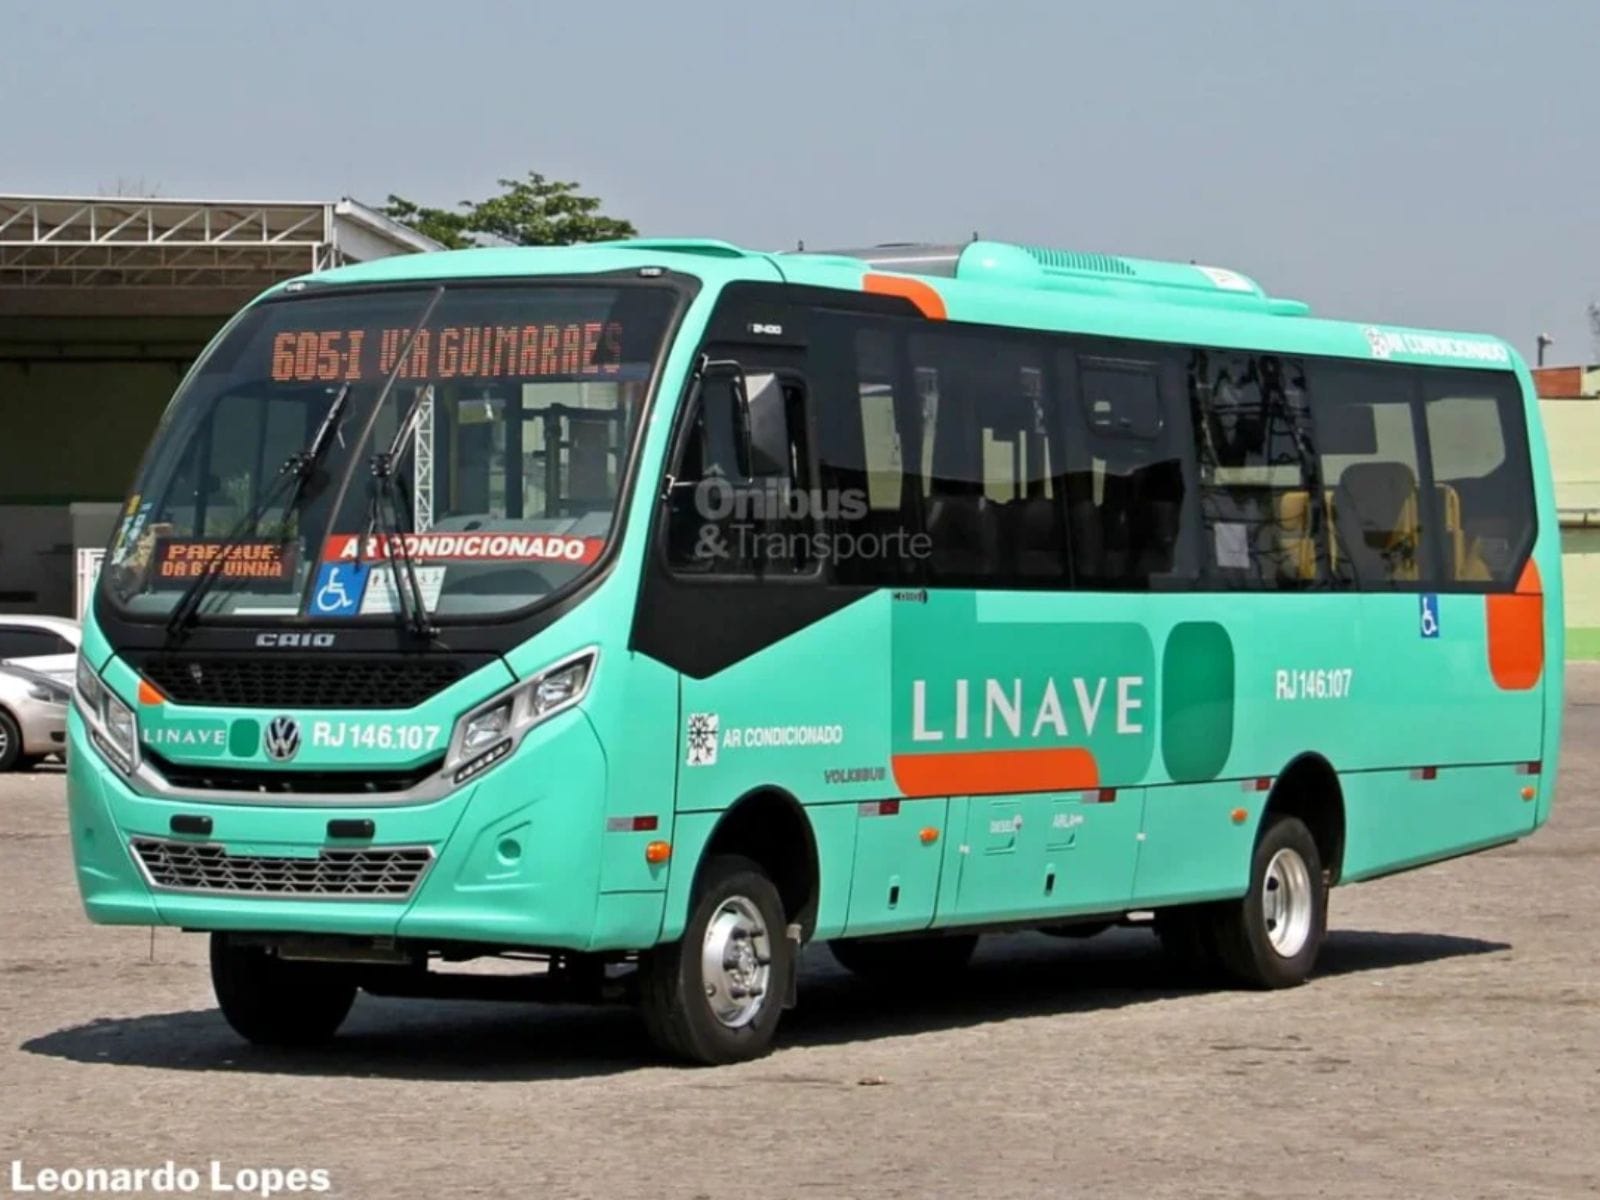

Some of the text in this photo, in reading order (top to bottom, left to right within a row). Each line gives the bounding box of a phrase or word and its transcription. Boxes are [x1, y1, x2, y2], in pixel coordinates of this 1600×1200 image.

[438, 323, 623, 377] GUIMARAES
[383, 535, 585, 560] CONDICIONADO
[162, 560, 282, 576] DA BUINHA
[256, 633, 336, 648] CAIO
[912, 676, 1144, 742] LINAVE
[143, 728, 227, 746] LINAVE
[722, 725, 843, 749] AR CONDICIONADO
